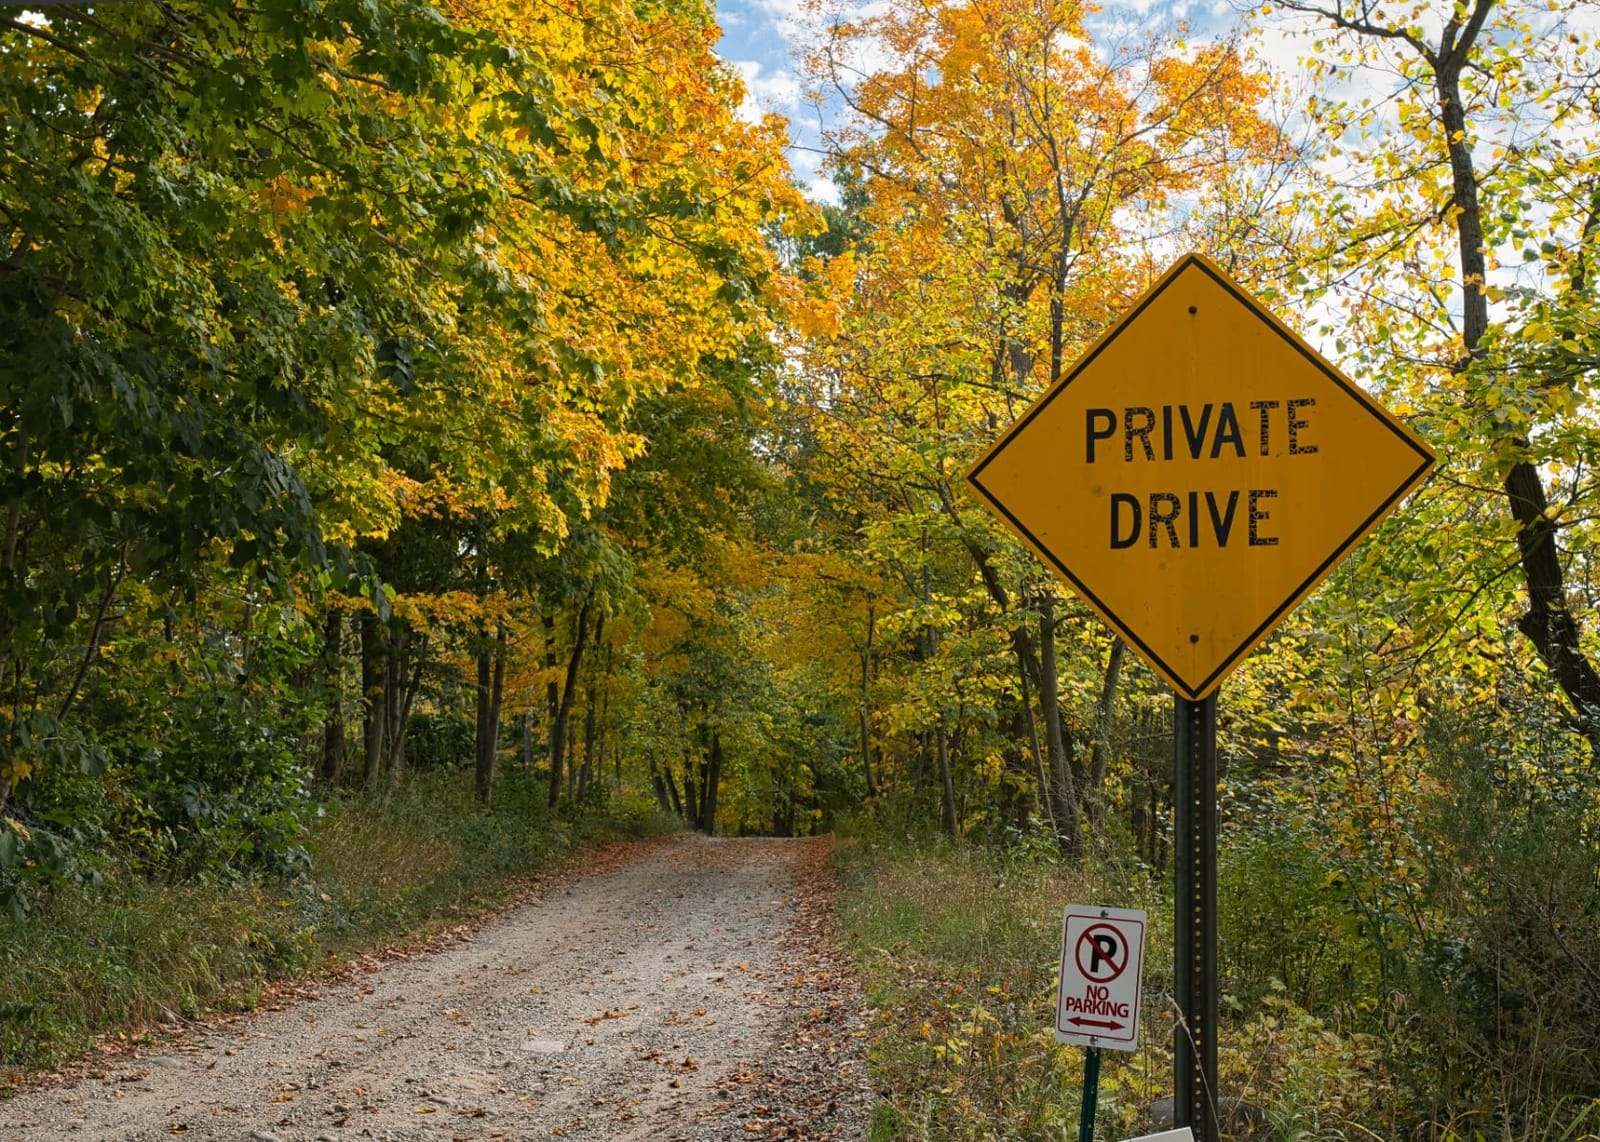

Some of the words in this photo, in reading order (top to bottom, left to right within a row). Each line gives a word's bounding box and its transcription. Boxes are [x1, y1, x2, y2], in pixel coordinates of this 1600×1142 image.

[1086, 398, 1318, 463] PRIVATE
[1110, 489, 1279, 549] DRIVE
[1090, 935, 1117, 973] P
[1066, 997, 1129, 1018] PARKING
[1086, 985, 1109, 1001] NO
